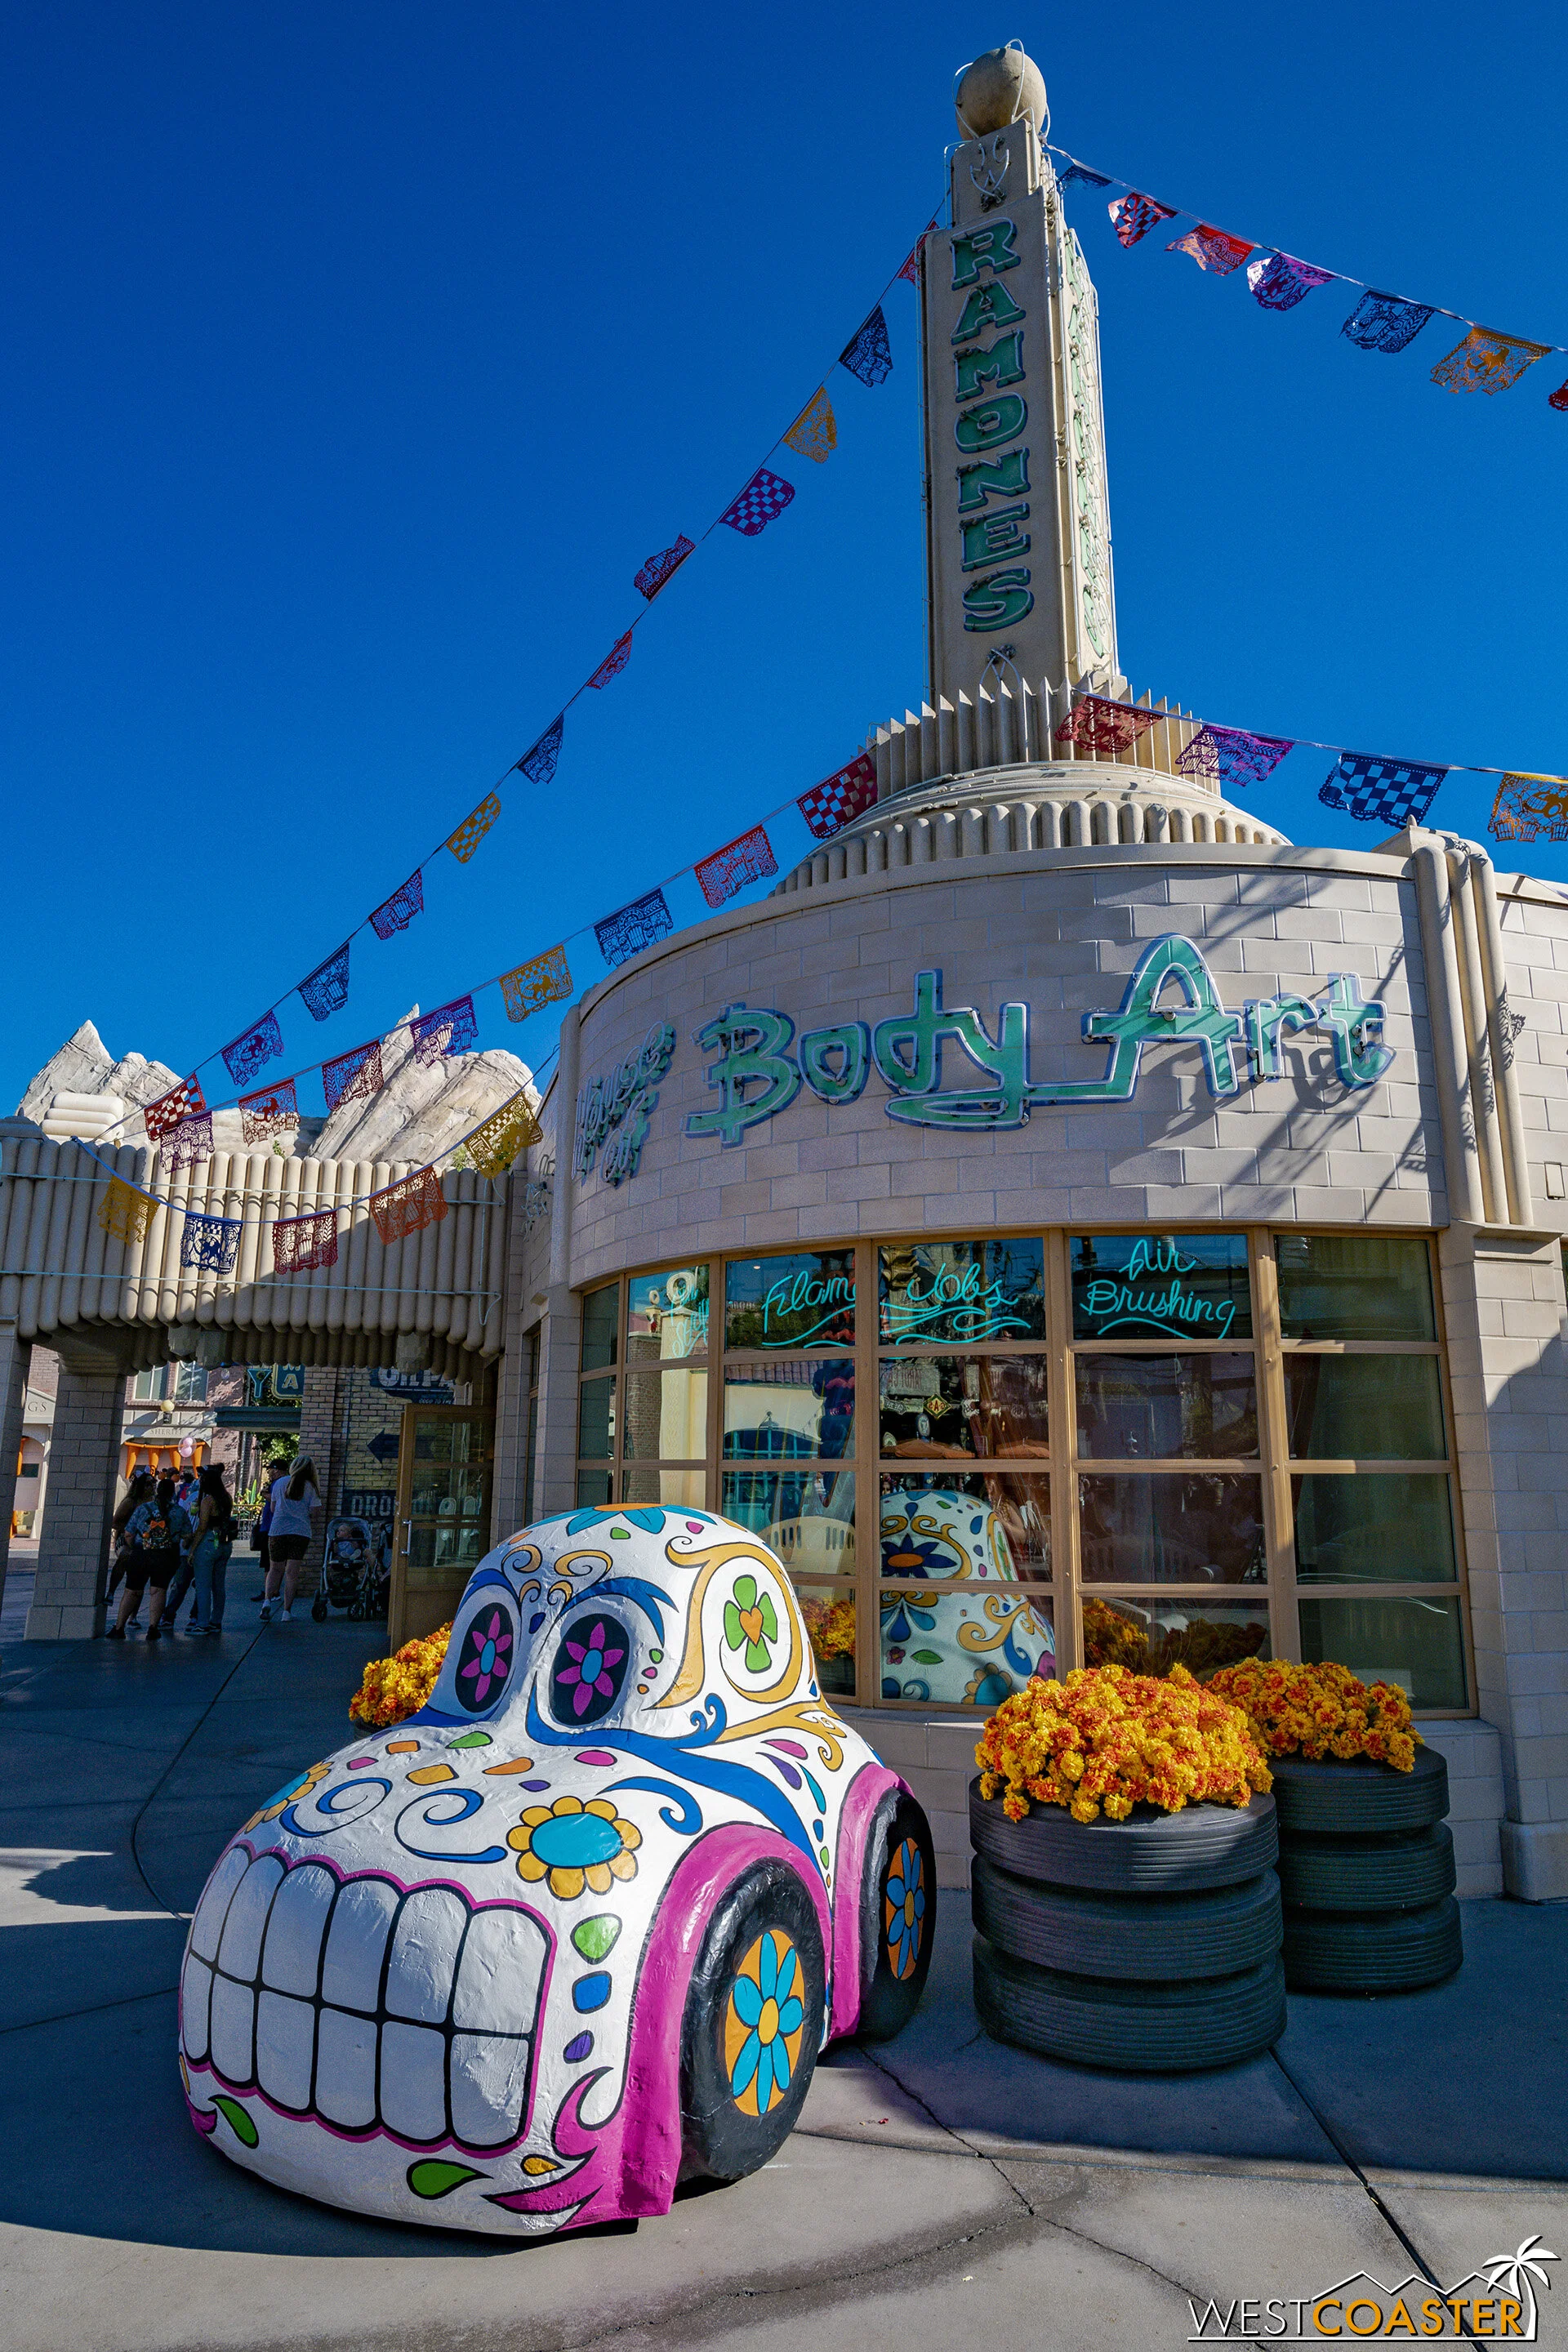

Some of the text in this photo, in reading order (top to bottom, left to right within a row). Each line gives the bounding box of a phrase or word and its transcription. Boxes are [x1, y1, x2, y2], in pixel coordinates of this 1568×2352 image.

[949, 216, 1035, 633] RAMONES
[679, 932, 1396, 1148] Body Art
[906, 1263, 1019, 1307] Jobs
[1118, 1238, 1197, 1281] Air
[1080, 1279, 1236, 1339] Brushing
[351, 1495, 398, 1517] DRO
